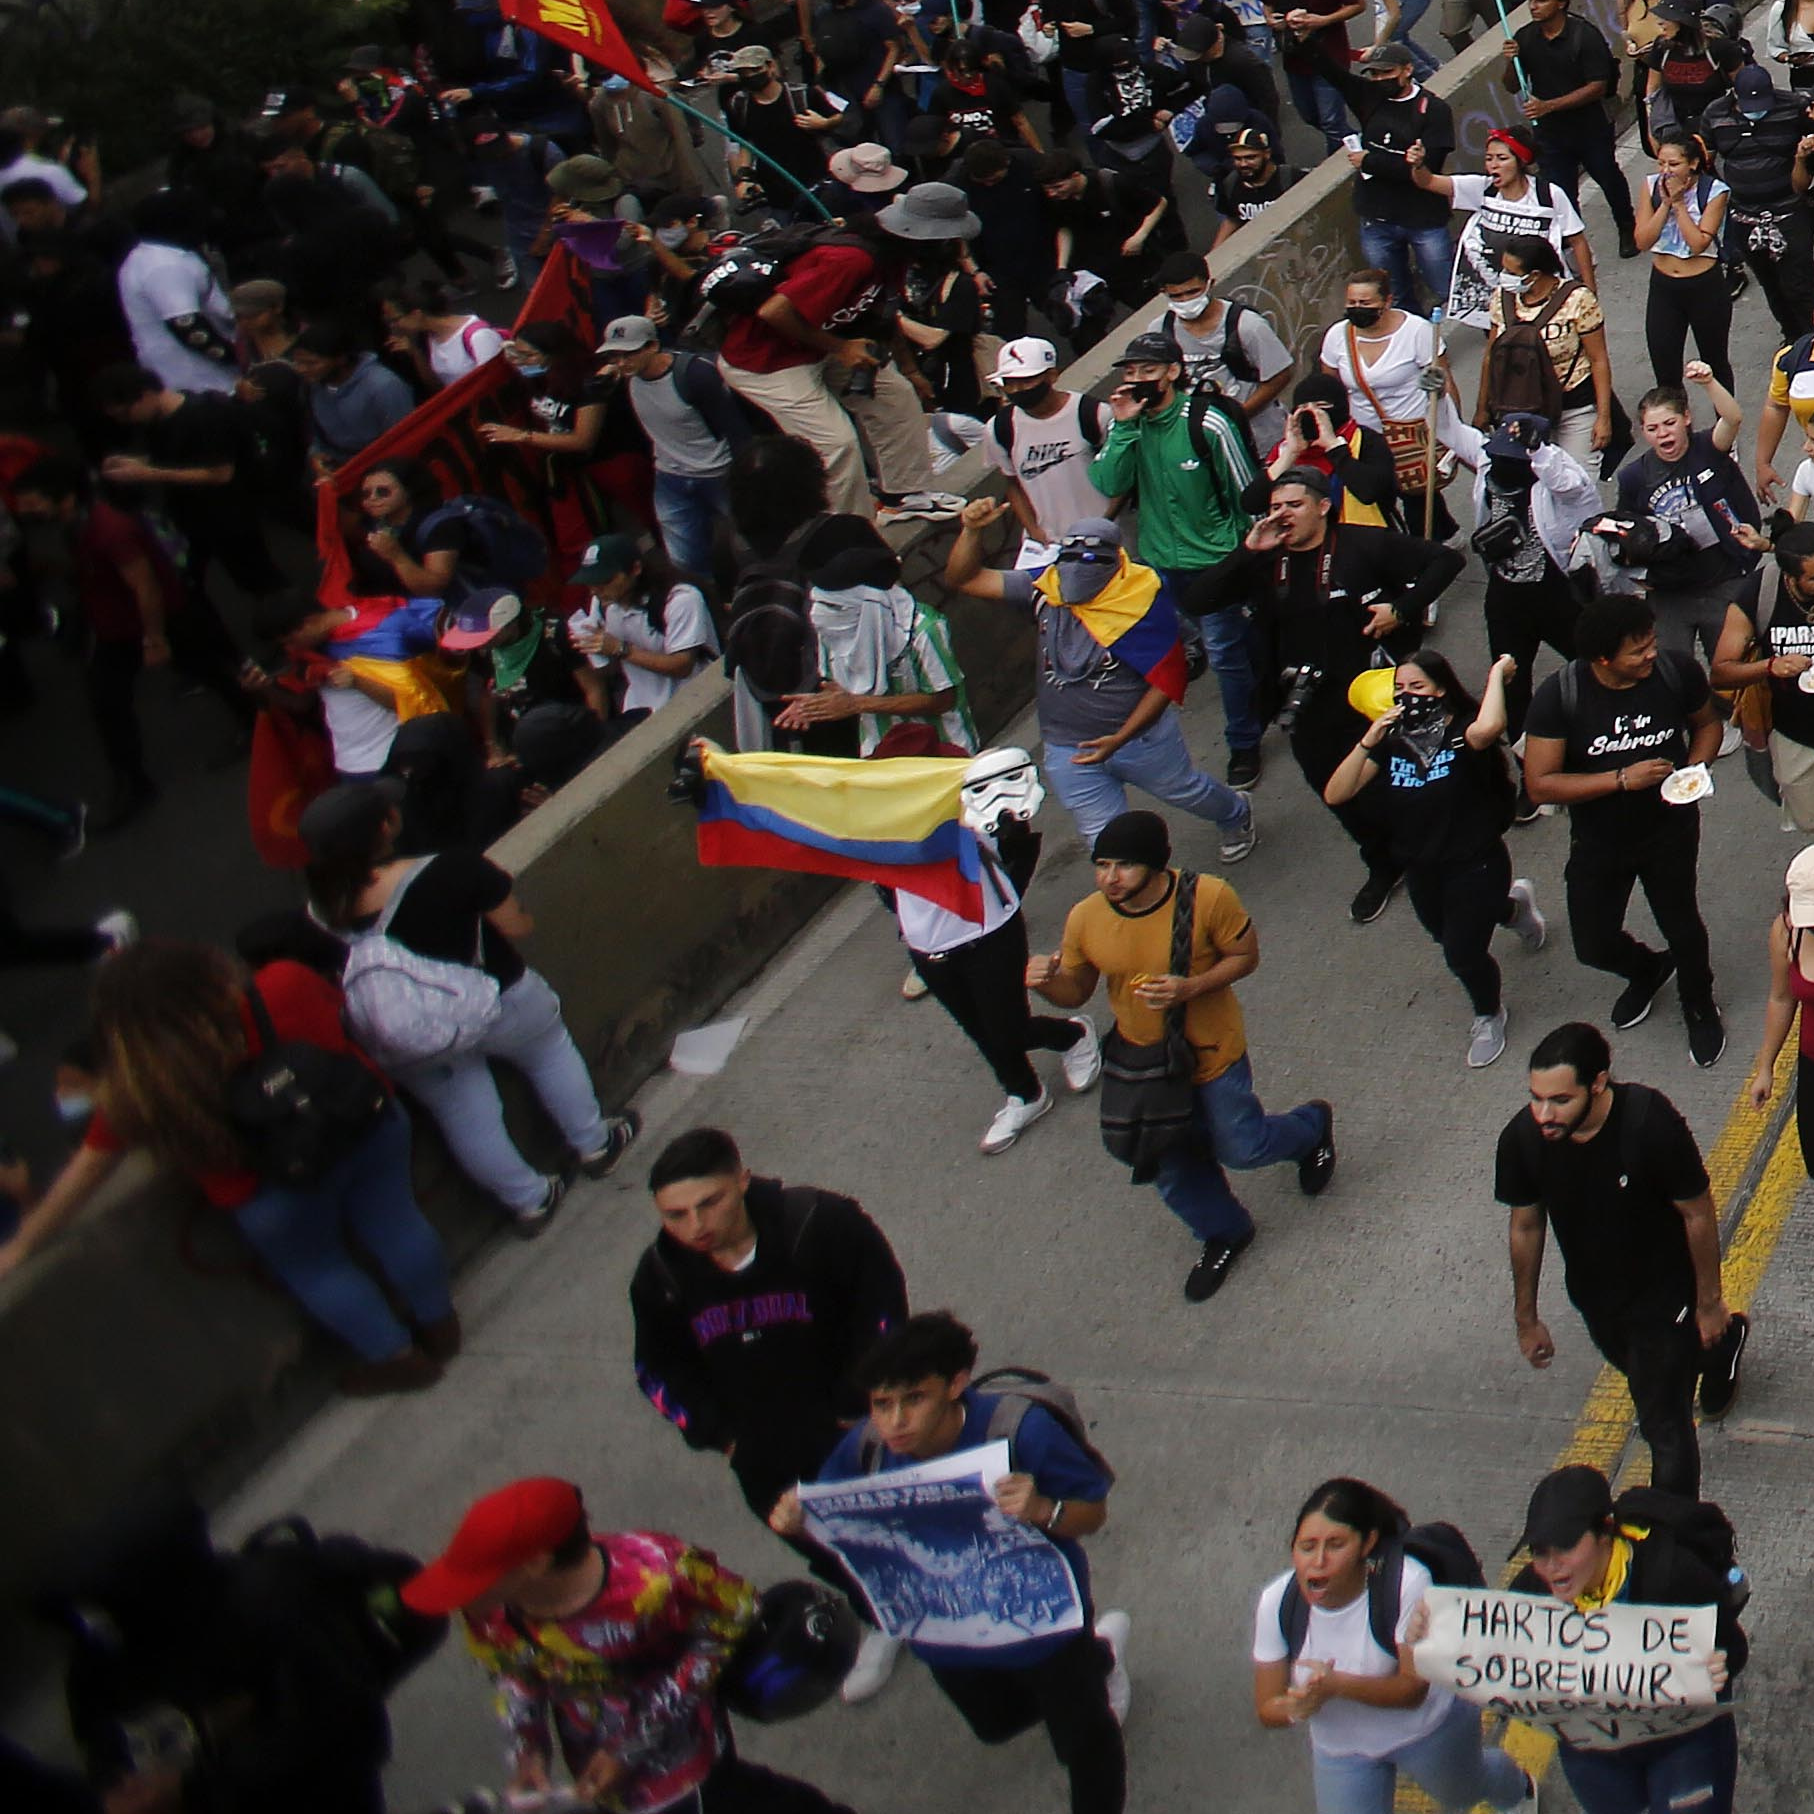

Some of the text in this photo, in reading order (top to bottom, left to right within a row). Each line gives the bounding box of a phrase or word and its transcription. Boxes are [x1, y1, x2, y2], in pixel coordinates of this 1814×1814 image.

[1028, 441, 1072, 462] NIKE
[1587, 727, 1675, 757] Sabroso
[1461, 1598, 1692, 1653] HARTOS DE
[1455, 1652, 1688, 1706] SOBREVIVIR,
